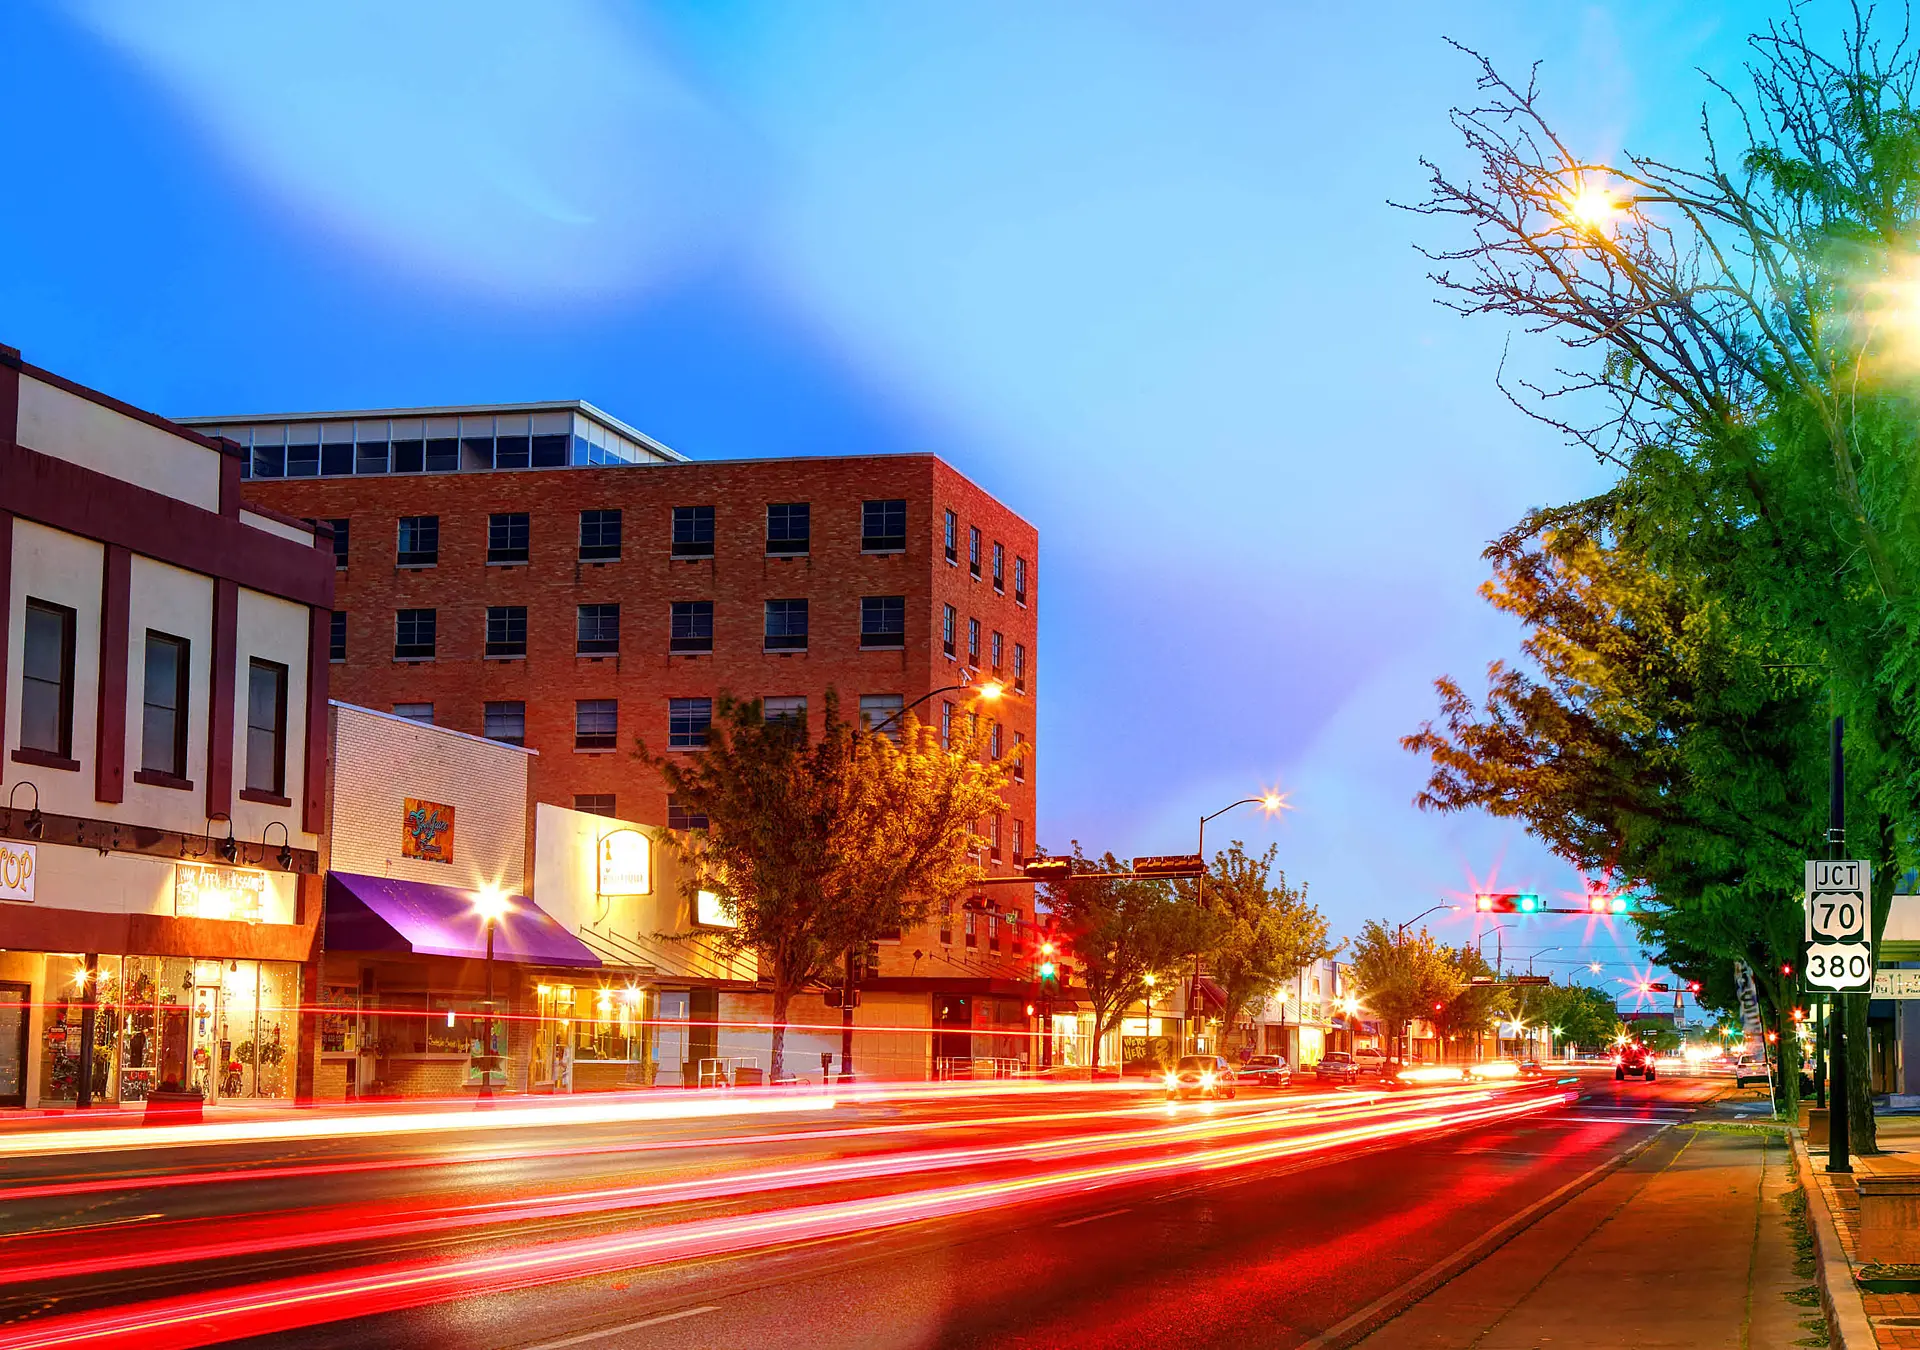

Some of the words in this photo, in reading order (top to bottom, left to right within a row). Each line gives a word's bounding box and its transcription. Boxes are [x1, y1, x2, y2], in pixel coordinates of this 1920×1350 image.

[1818, 865, 1857, 886] JCT
[1819, 903, 1855, 929] 70
[1811, 955, 1865, 977] 380
[1123, 1046, 1147, 1061] HERE
